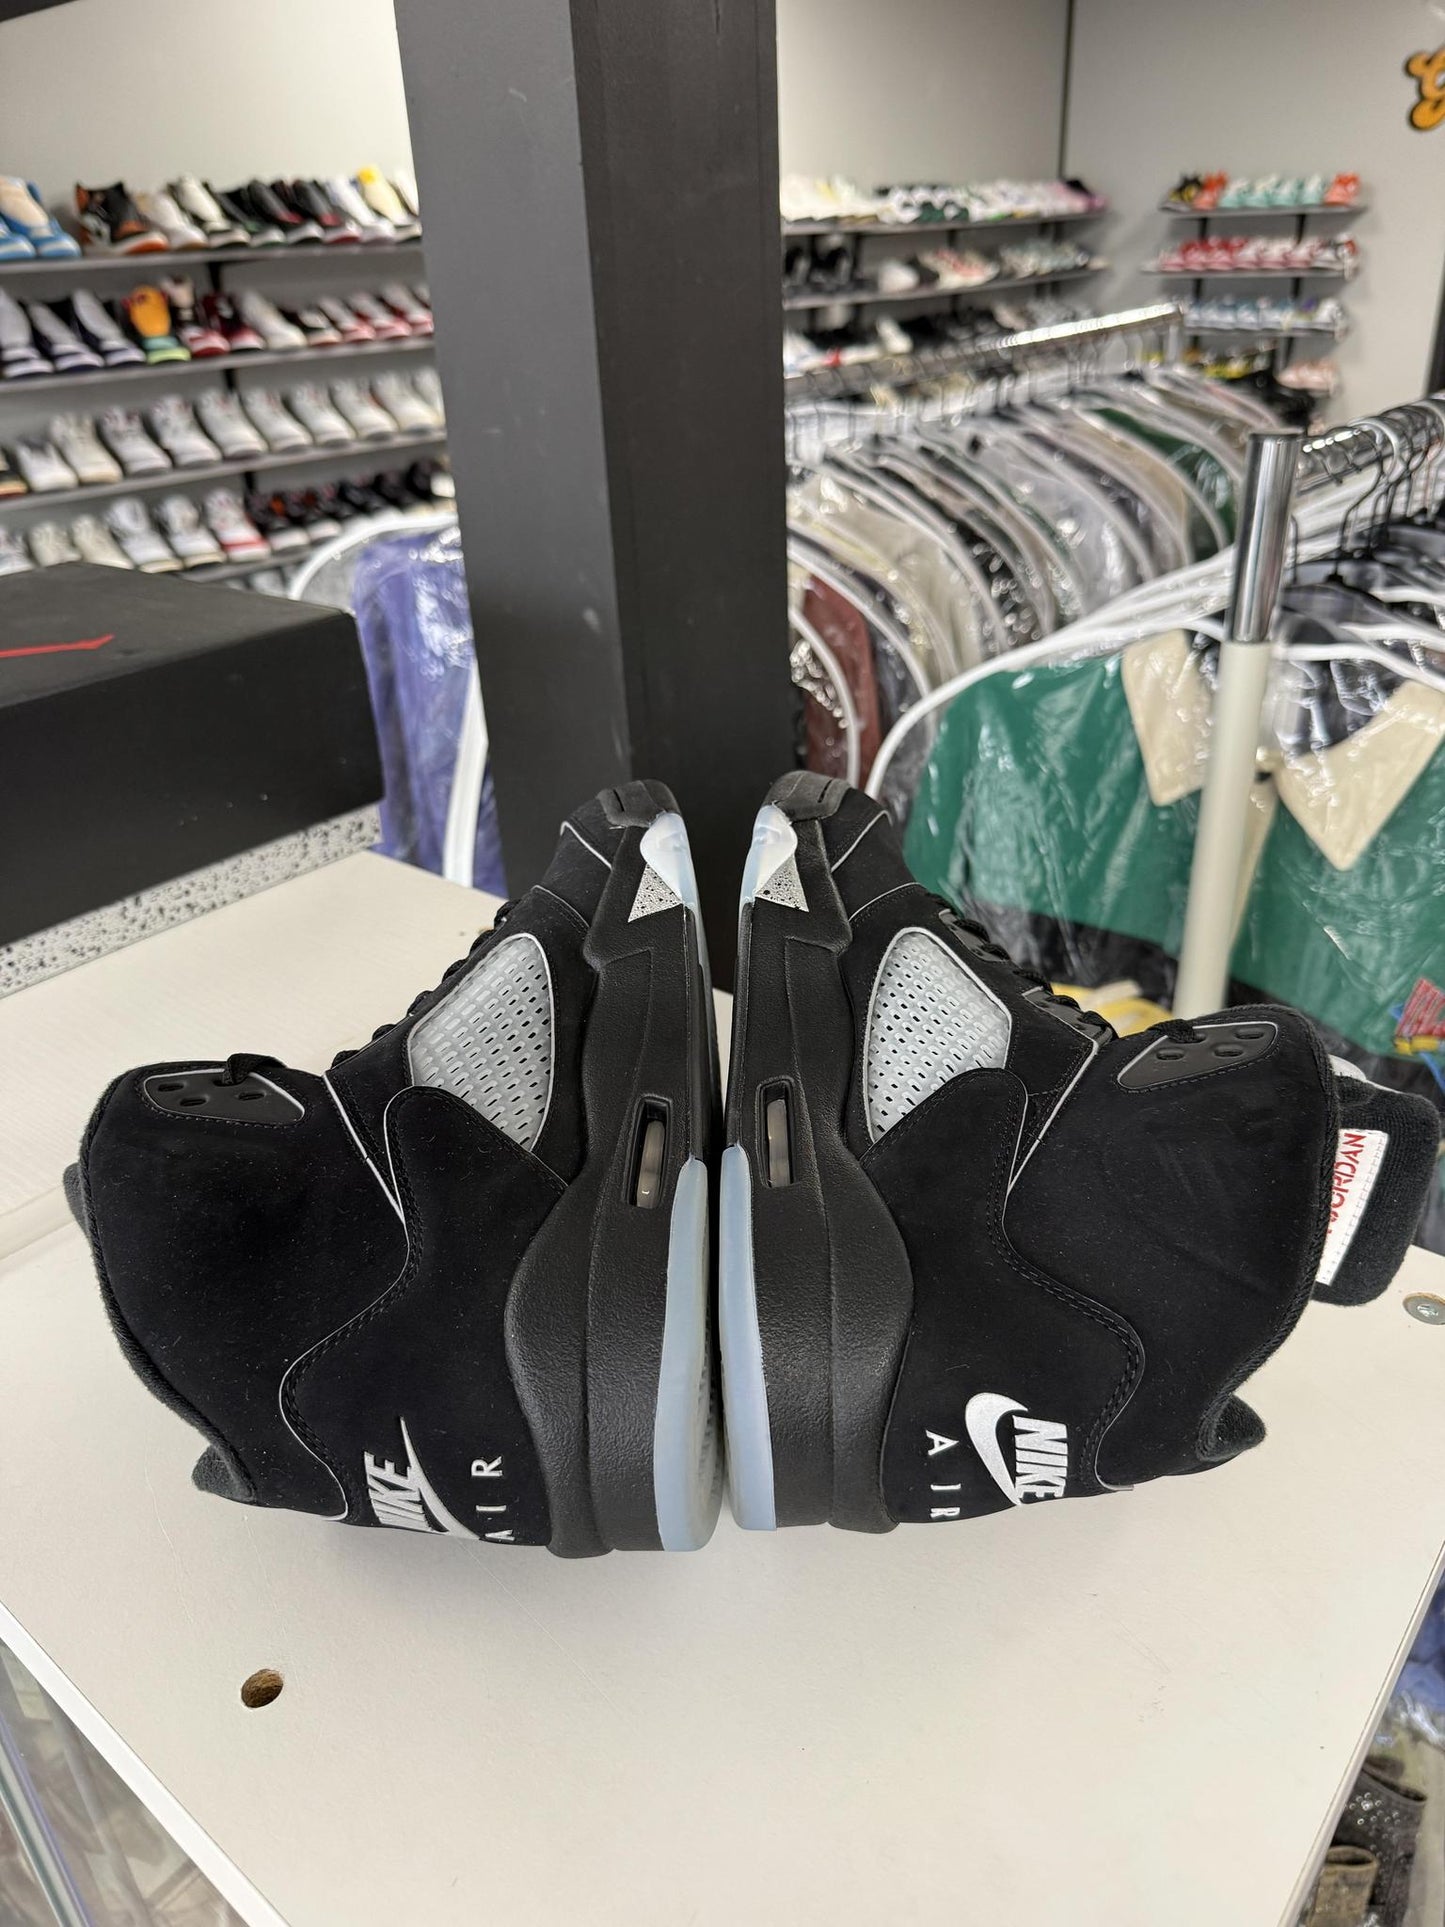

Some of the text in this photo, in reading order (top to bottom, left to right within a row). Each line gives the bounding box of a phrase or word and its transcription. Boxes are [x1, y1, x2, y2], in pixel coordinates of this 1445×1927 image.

[471, 1456, 516, 1541] AIR
[925, 1429, 962, 1518] AIR
[1012, 1415, 1068, 1500] NIKE
